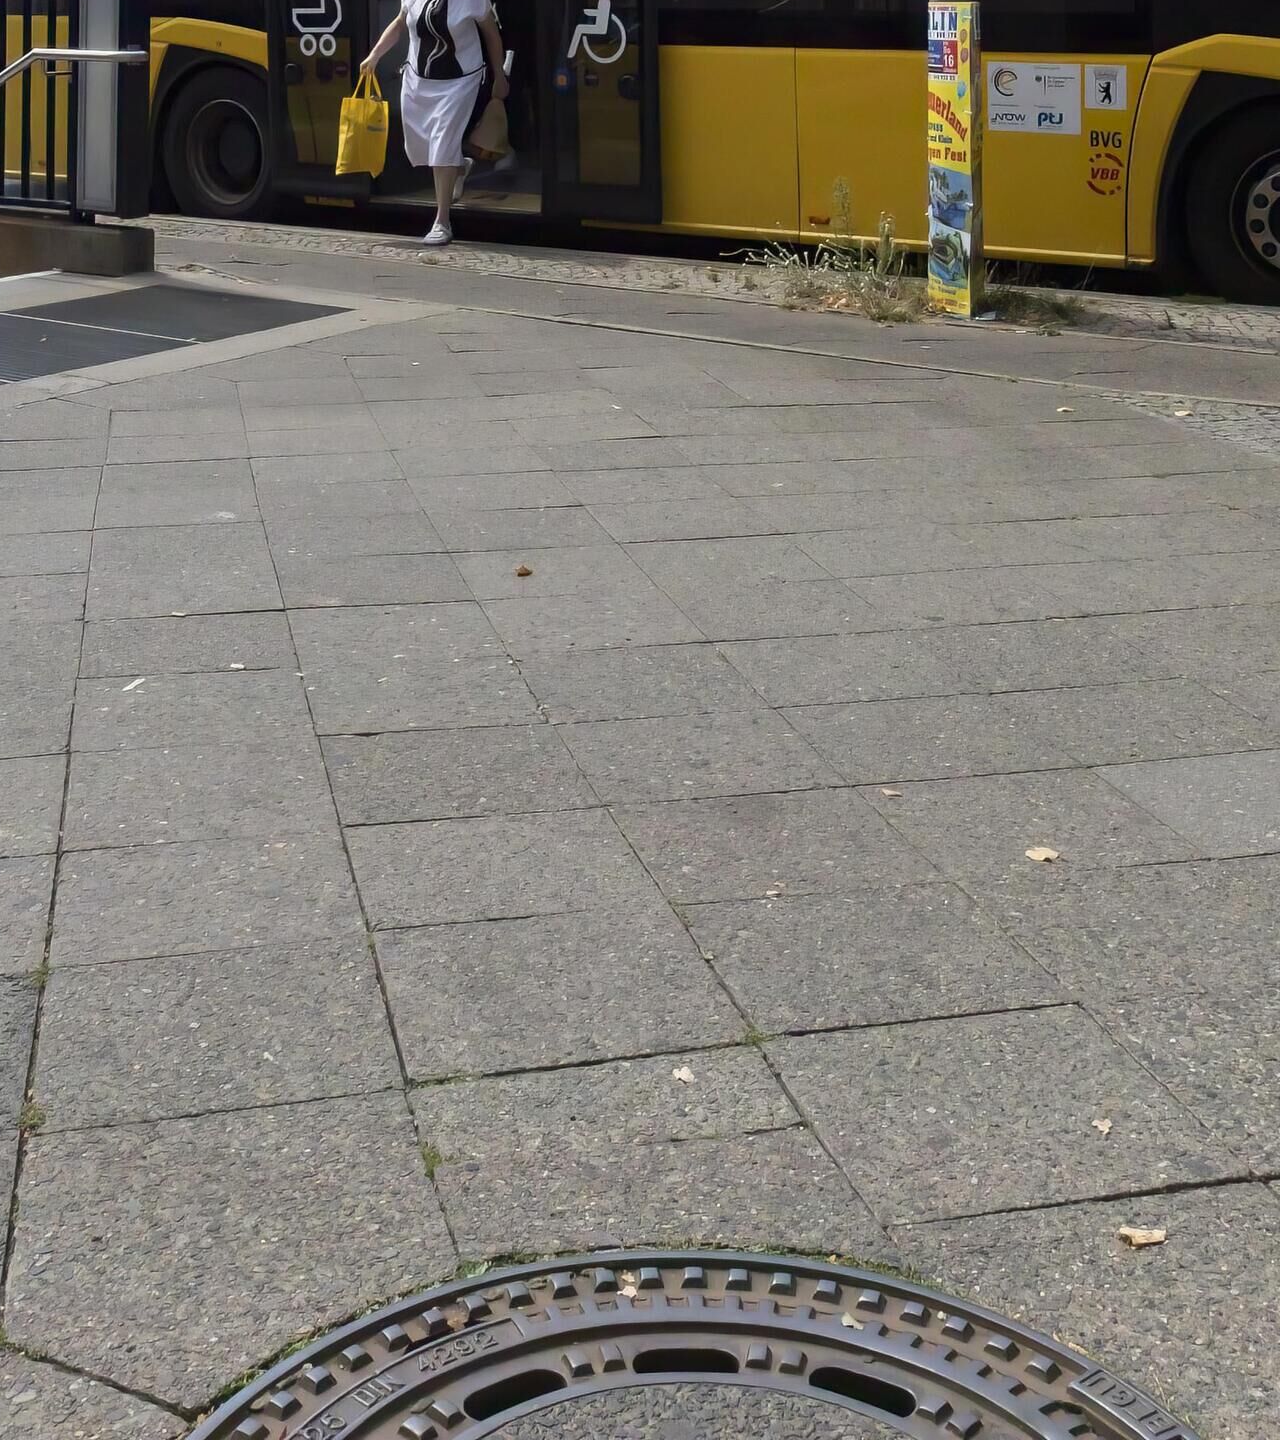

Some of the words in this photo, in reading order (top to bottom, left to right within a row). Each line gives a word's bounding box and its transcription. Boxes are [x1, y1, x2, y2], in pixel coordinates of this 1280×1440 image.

[1089, 130, 1123, 149] BVG
[1090, 167, 1121, 181] VBB
[351, 1375, 407, 1408] DIN
[419, 1331, 500, 1372] 4292
